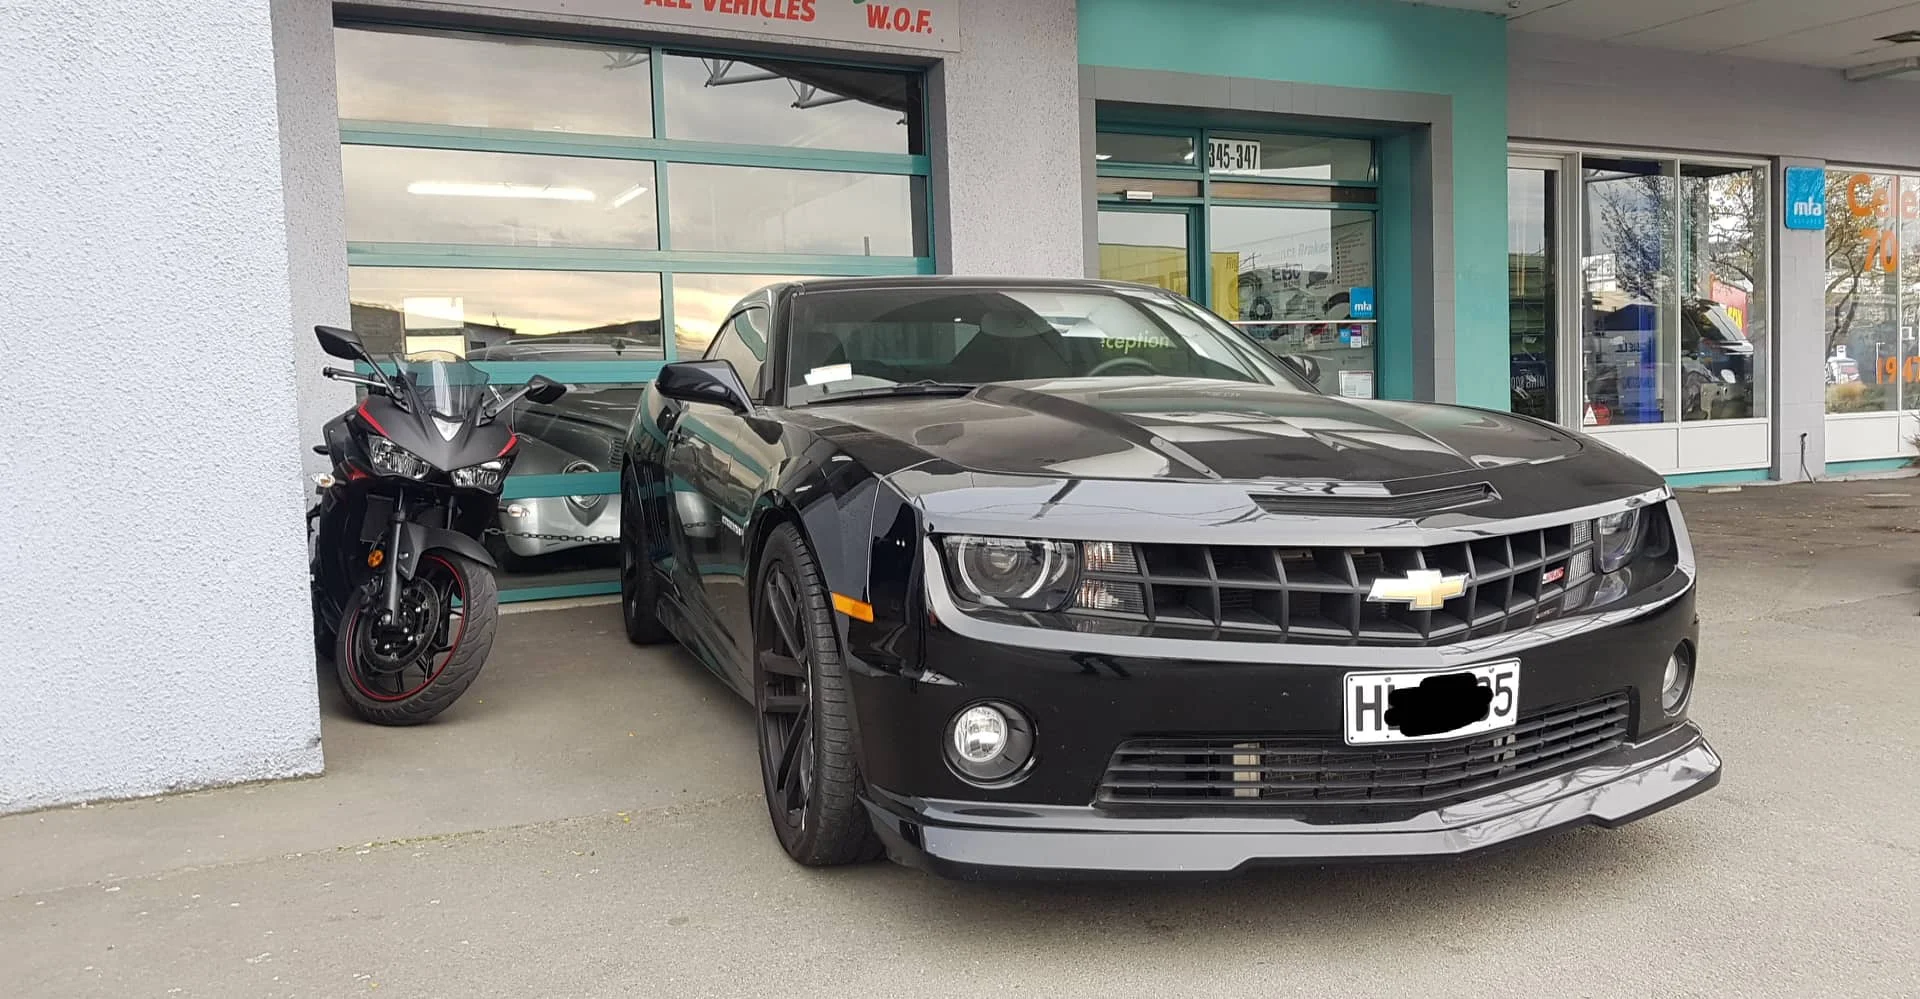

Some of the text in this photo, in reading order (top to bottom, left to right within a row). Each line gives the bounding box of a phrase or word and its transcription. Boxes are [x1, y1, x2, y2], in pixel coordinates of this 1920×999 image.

[703, 0, 816, 22] VEHICLES
[867, 4, 932, 34] W.O.F.
[1209, 143, 1257, 169] 345-347
[1860, 228, 1897, 272] 70
[1101, 330, 1169, 354] ception
